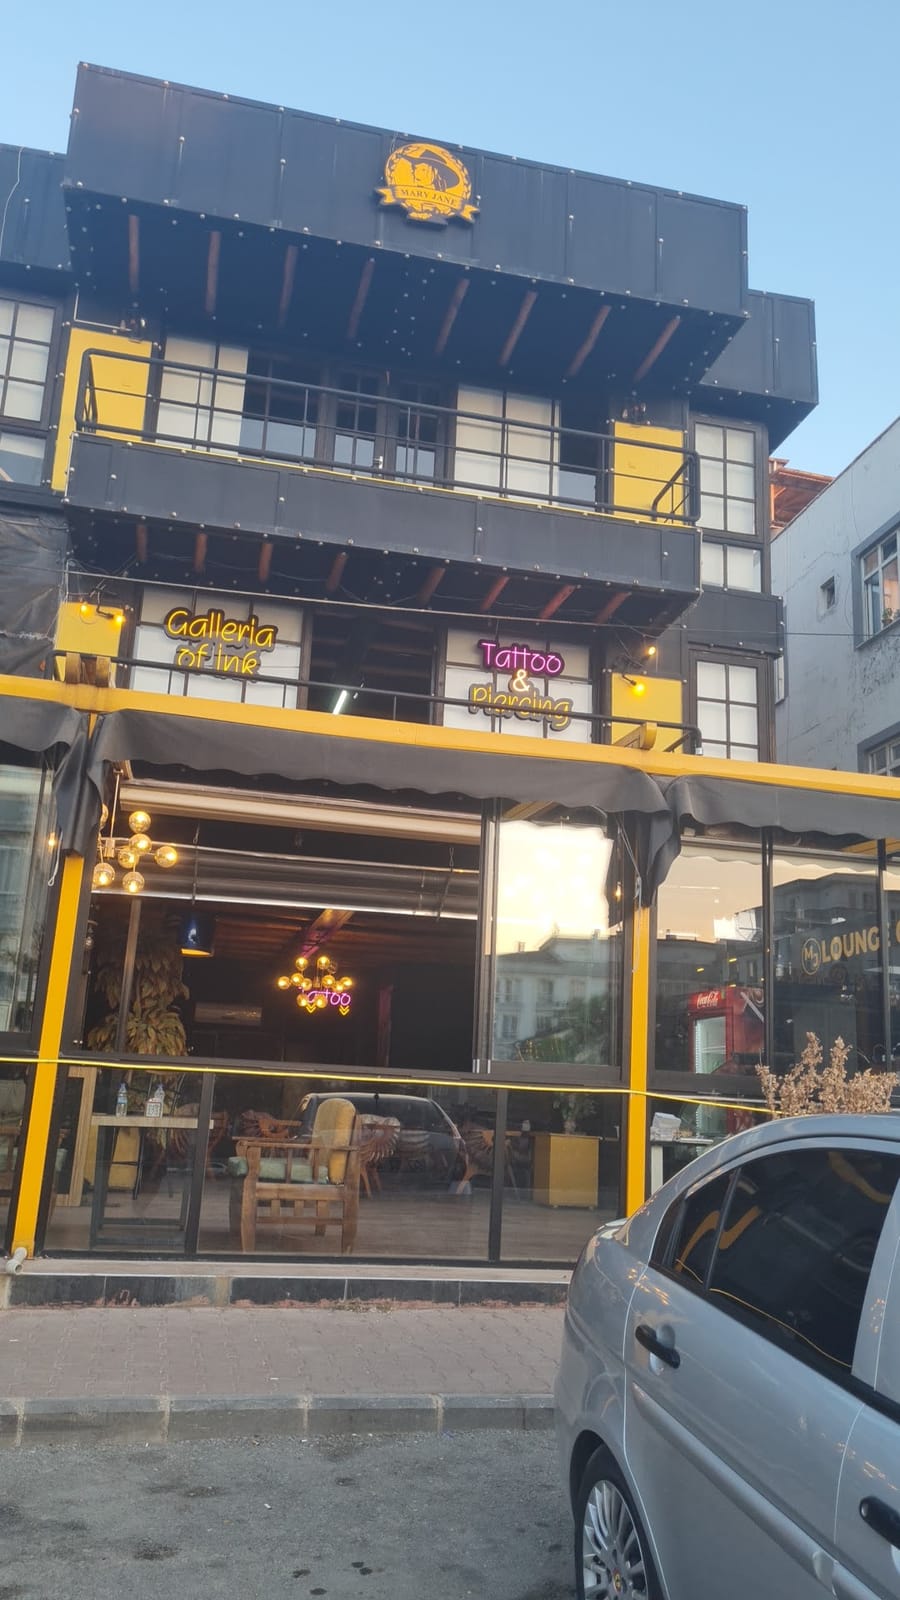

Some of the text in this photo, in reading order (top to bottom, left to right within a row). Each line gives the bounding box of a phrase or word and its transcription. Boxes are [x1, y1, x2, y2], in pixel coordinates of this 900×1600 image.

[400, 189, 457, 207] MARY JANE
[167, 610, 275, 648] Galleria
[177, 643, 209, 669] of
[481, 642, 562, 674] Tattoo
[512, 668, 531, 692] &
[821, 922, 890, 964] LOUNG
